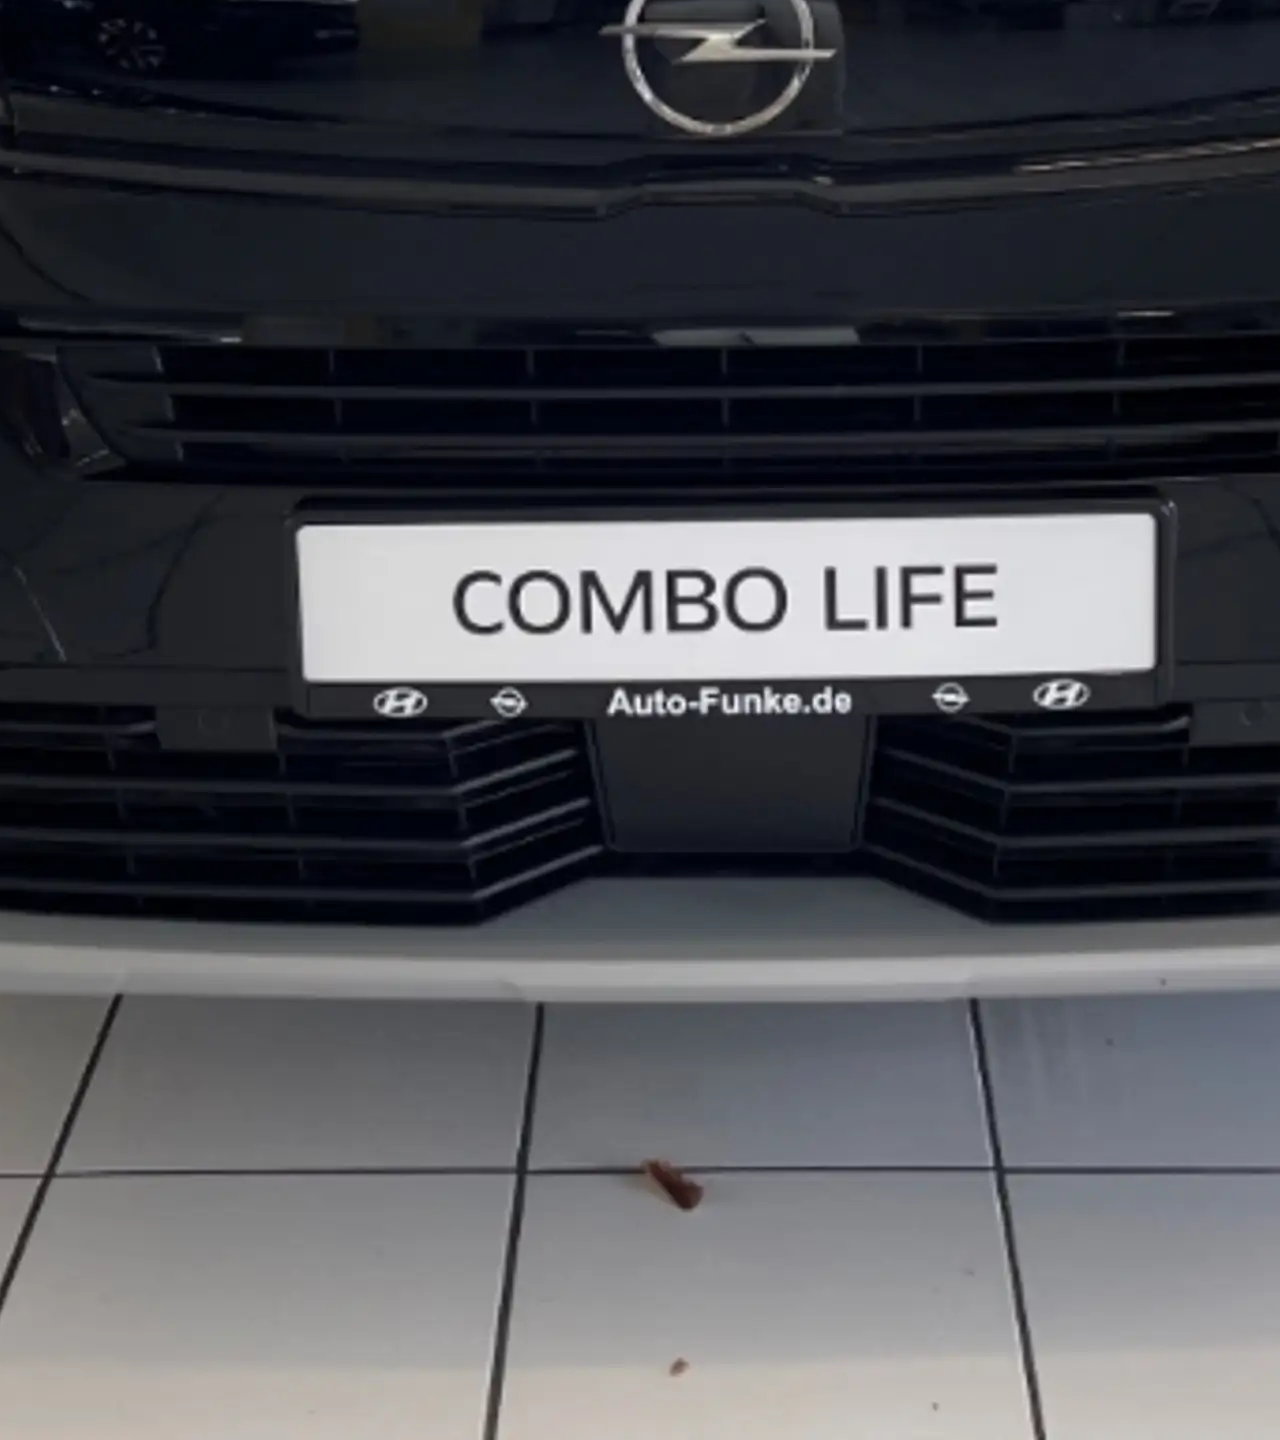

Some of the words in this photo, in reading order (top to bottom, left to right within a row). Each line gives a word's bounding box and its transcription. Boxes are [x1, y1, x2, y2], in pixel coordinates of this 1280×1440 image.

[453, 568, 787, 635] COMBO
[824, 565, 998, 630] LIFE
[606, 685, 853, 716] Auto-Funke.de
